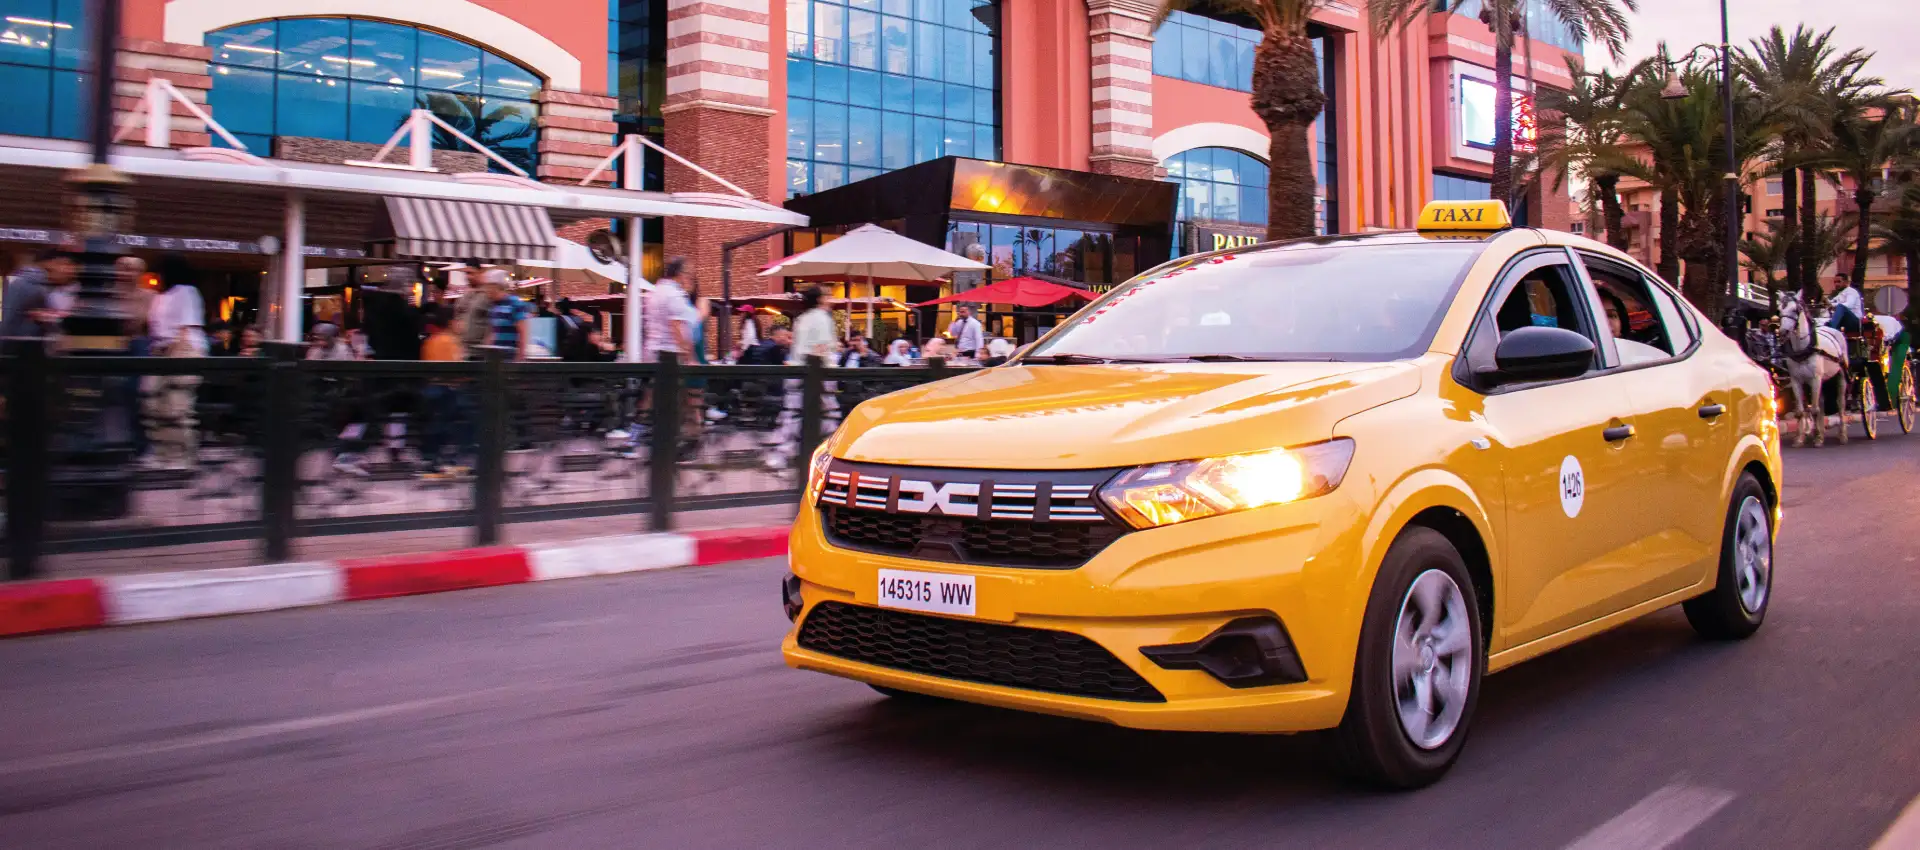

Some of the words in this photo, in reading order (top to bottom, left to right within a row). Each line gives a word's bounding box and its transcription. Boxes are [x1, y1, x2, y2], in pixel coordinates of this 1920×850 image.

[1432, 208, 1484, 222] TAXI
[1562, 472, 1582, 499] 1426
[880, 577, 932, 602] 145315
[940, 582, 972, 606] WW
